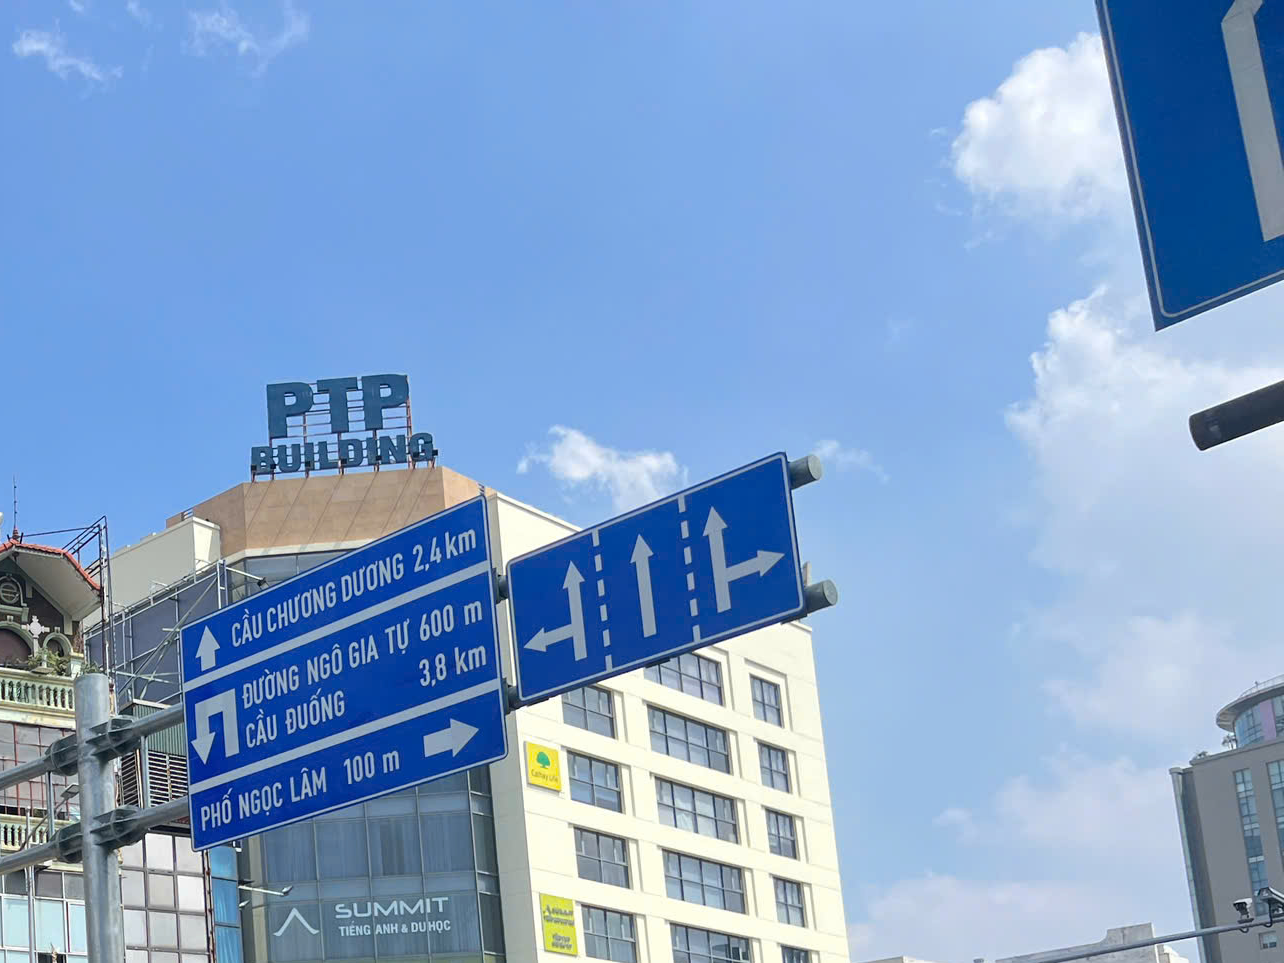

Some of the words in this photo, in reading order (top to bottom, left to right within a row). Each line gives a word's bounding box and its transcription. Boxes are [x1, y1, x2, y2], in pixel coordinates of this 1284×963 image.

[266, 373, 410, 439] PTP
[251, 432, 438, 475] BUILDING
[231, 606, 263, 648] CẦU
[267, 581, 337, 633] CHƯƠNG
[341, 552, 405, 603] DƯƠNG
[412, 536, 443, 573] 2,4
[444, 527, 477, 560] km
[242, 664, 300, 709] ĐƯỜNG
[306, 643, 344, 685] NGÔ
[348, 636, 380, 669] GIA
[385, 619, 411, 662] TỰ
[418, 605, 455, 643] 600
[463, 600, 483, 625] m
[245, 707, 278, 749] CẦU
[284, 688, 346, 735] ĐUỐNG
[418, 656, 447, 689] 3,8
[454, 641, 487, 675] km
[200, 788, 233, 832] PHỐ
[237, 781, 285, 820] NGỌC
[289, 761, 328, 803] LÂM
[343, 752, 376, 782] 100
[381, 749, 400, 775] m
[335, 896, 449, 919] SUMMIT
[338, 920, 371, 937] TIẾNG
[375, 923, 398, 935] ANH
[401, 923, 409, 934] &
[411, 921, 427, 933] DU
[428, 920, 451, 934] HỌC
